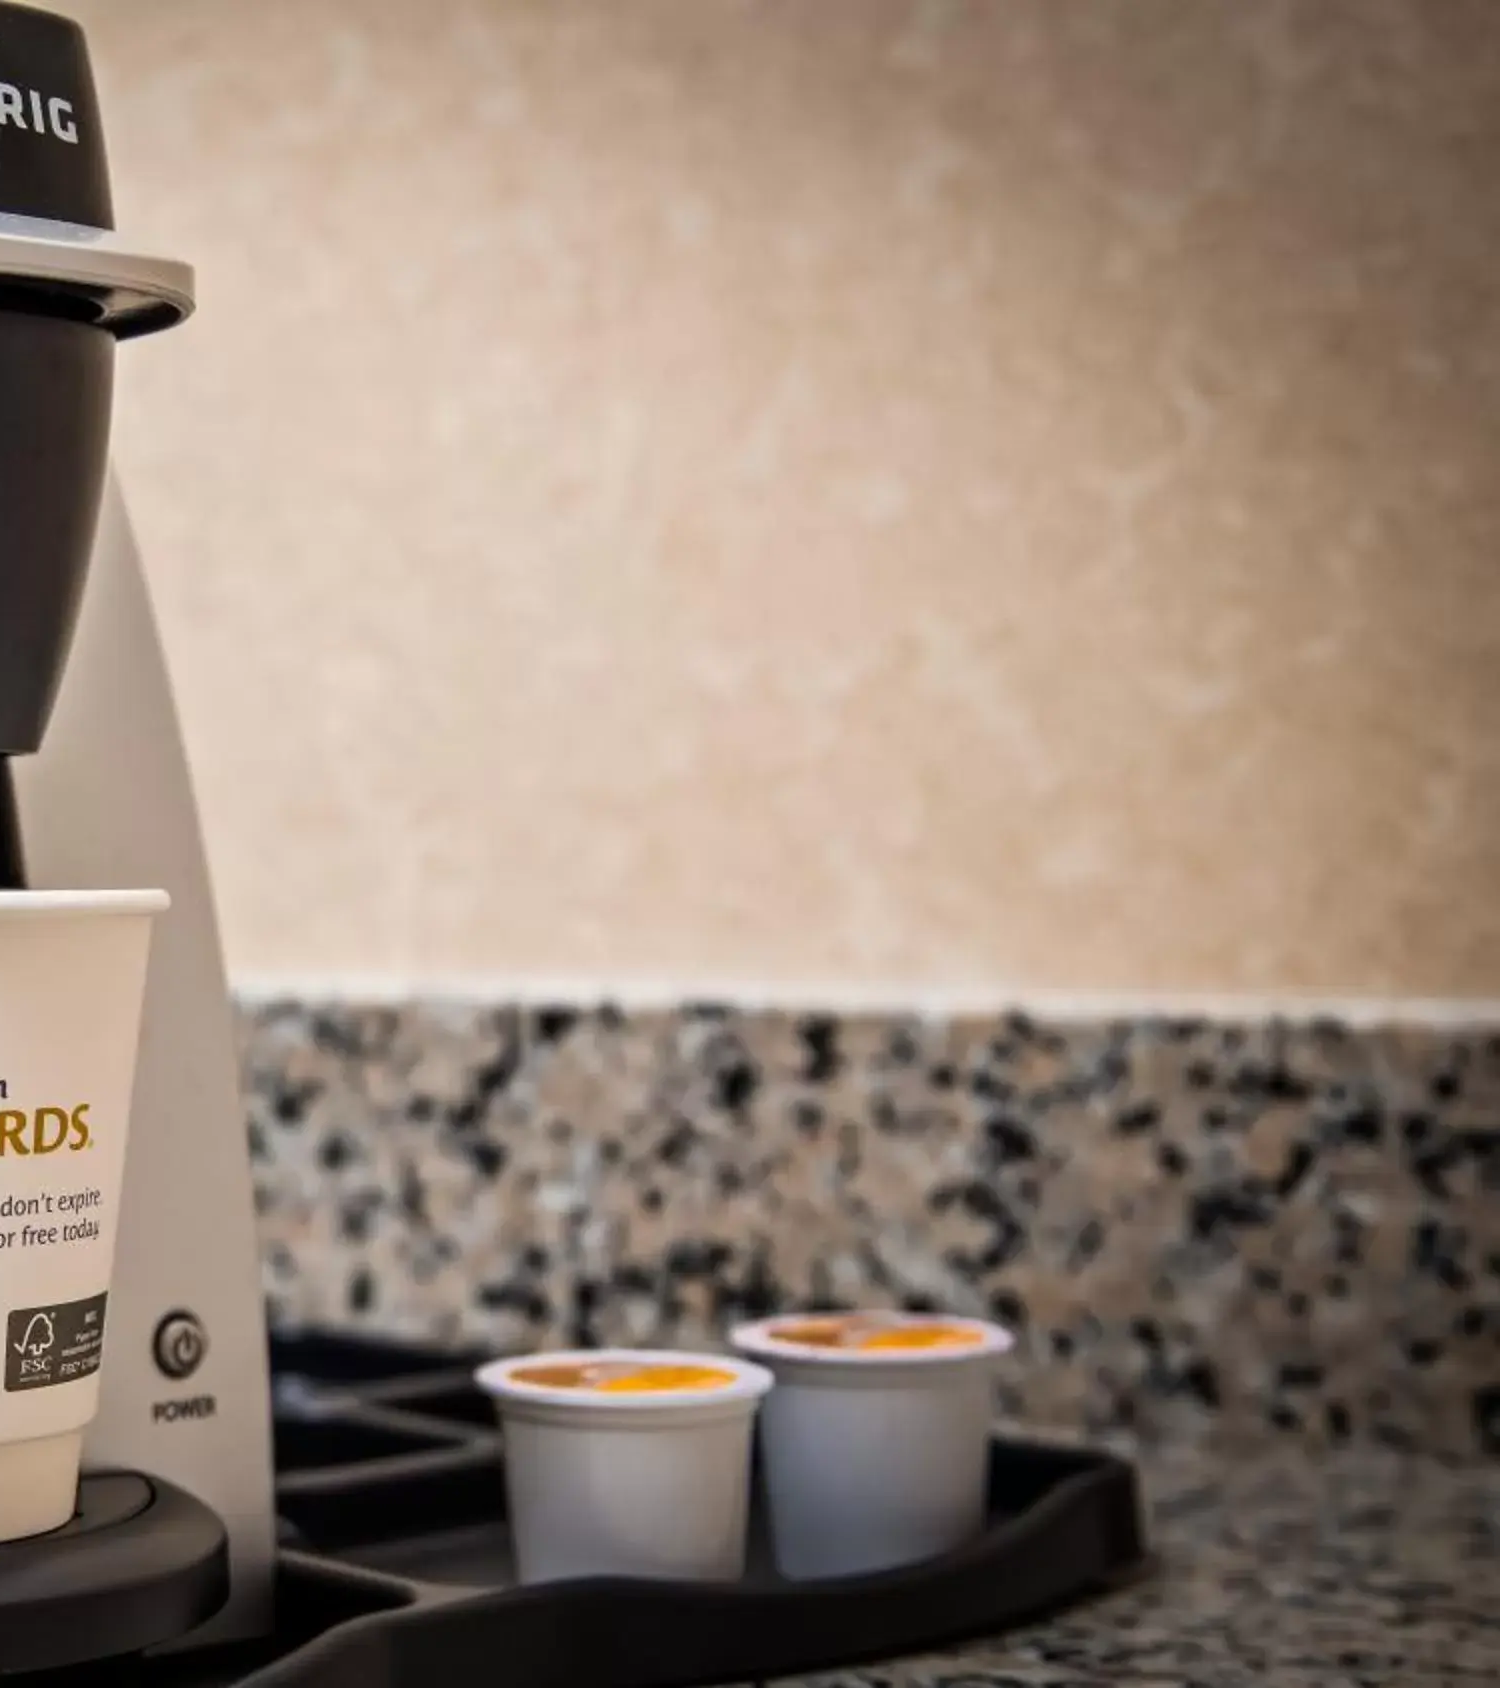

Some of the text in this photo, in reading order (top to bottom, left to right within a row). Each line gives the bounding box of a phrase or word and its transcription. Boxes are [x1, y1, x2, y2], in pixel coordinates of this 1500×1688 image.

[0, 1194, 53, 1217] don't
[22, 1225, 57, 1246] free
[152, 1394, 217, 1423] POWER
